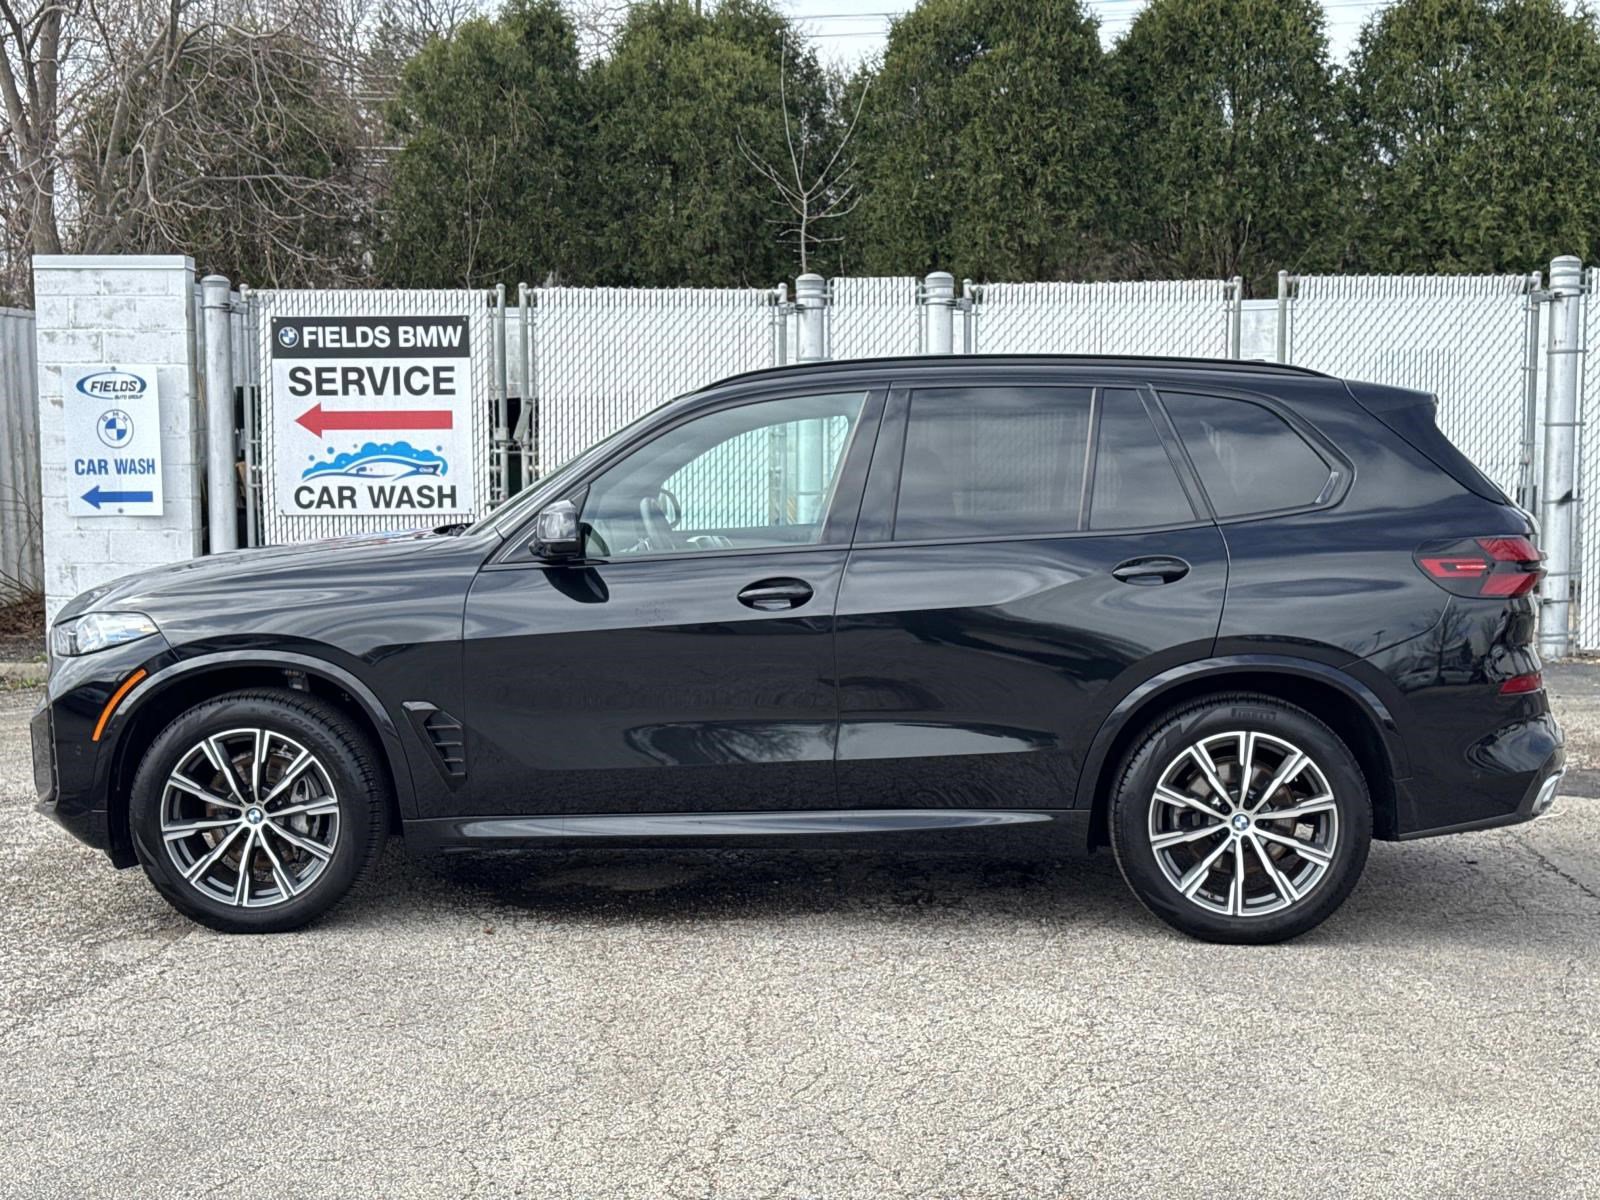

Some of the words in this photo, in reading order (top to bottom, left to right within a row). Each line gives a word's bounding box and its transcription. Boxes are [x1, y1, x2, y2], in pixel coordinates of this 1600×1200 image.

[302, 325, 391, 349] FIELDS
[397, 325, 463, 348] BMW
[90, 380, 138, 393] FIELDS
[288, 366, 456, 397] SERVICE
[74, 458, 109, 476] CAR
[114, 458, 156, 475] WASH
[294, 485, 358, 510] CAR
[367, 485, 458, 509] WASH
